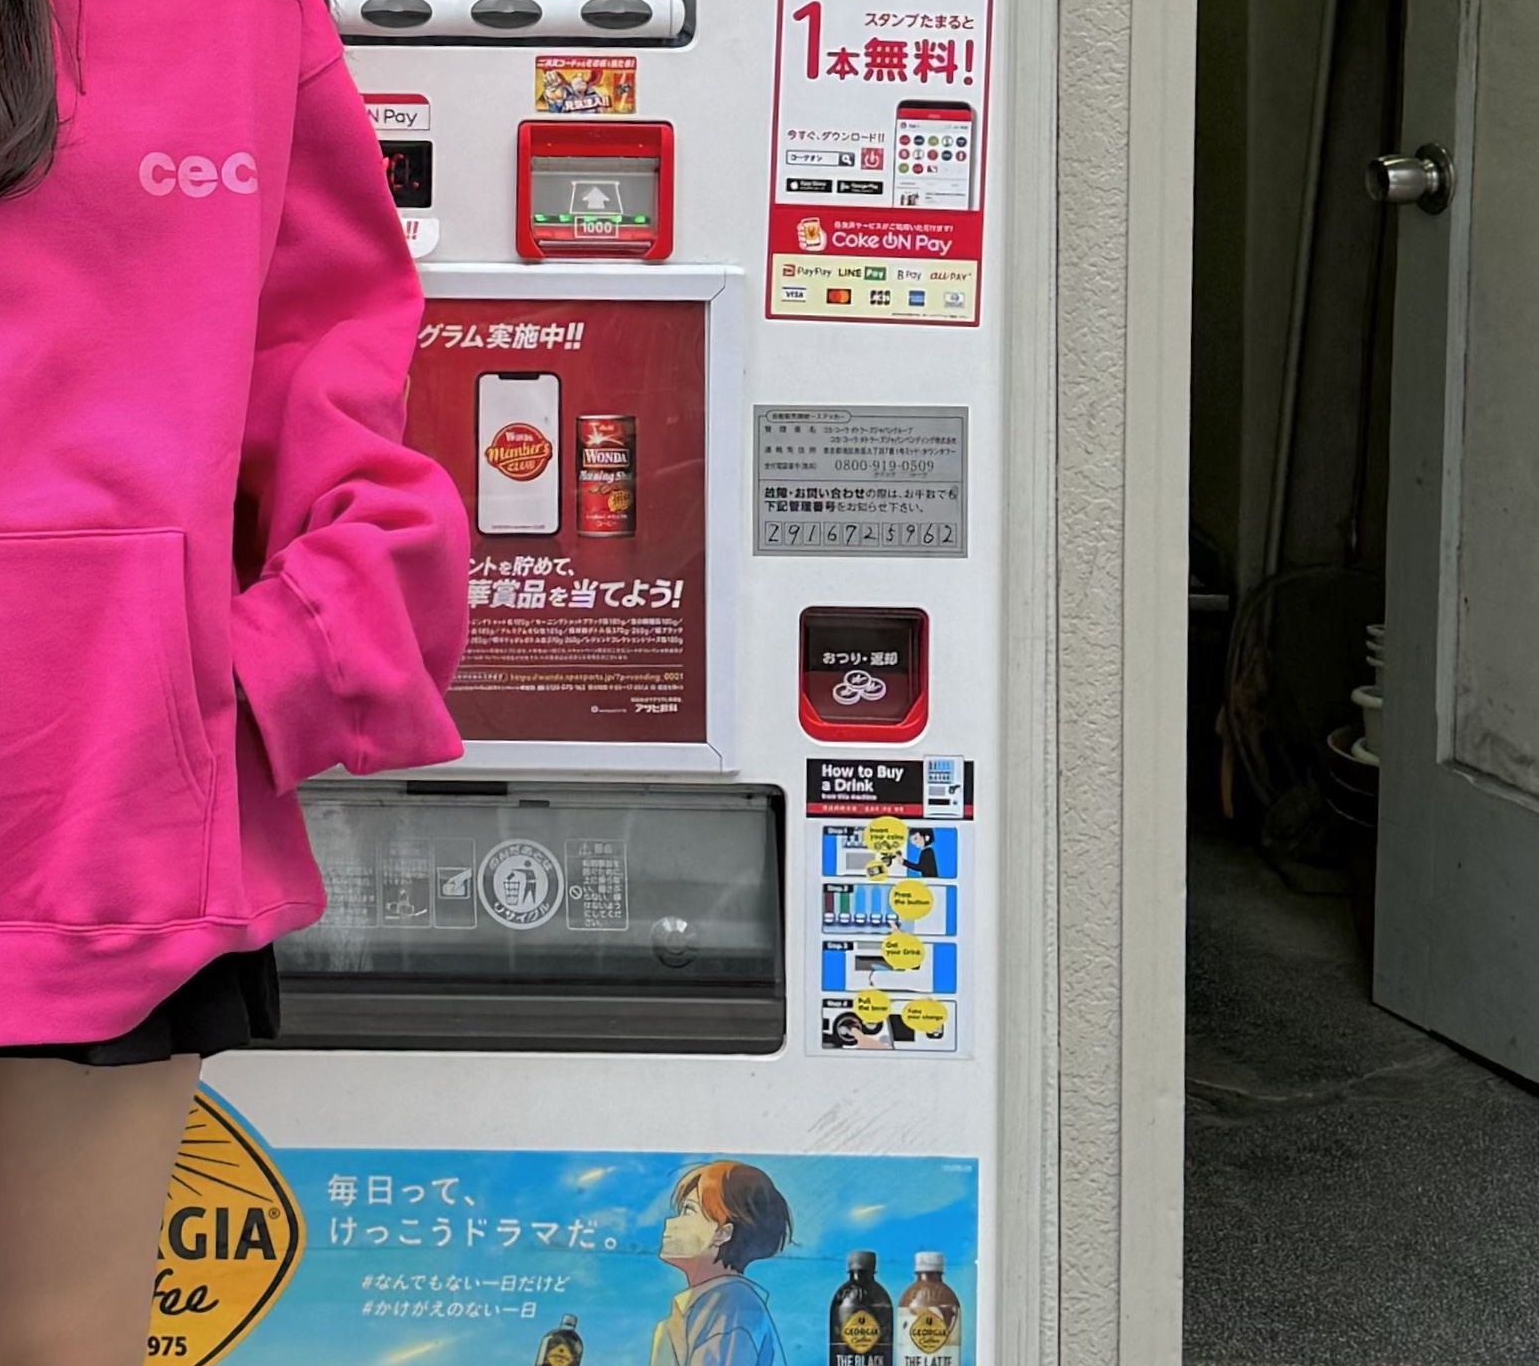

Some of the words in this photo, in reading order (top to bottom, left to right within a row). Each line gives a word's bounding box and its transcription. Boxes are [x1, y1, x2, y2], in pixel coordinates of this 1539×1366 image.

[865, 13, 974, 30] スタンプたまると
[384, 109, 418, 127] Pay
[580, 222, 613, 233] 1000
[832, 233, 879, 248] Coke
[915, 235, 953, 256] Pay
[797, 265, 832, 277] PayPay
[838, 268, 862, 278] LINE
[585, 449, 627, 464] WONDA
[835, 460, 934, 472] 0800-919-0509
[823, 651, 898, 665] おつり・返却
[822, 764, 854, 777] How
[858, 765, 873, 778] to
[877, 765, 903, 782] Buy
[822, 780, 831, 791] a
[834, 778, 874, 792] Drink
[327, 1174, 476, 1207] 毎日って、
[331, 1218, 618, 1250] けっこうドラマだ。
[361, 1274, 570, 1293] #なんでもない一日だけど
[361, 1300, 538, 1319] #かけがえのない一日
